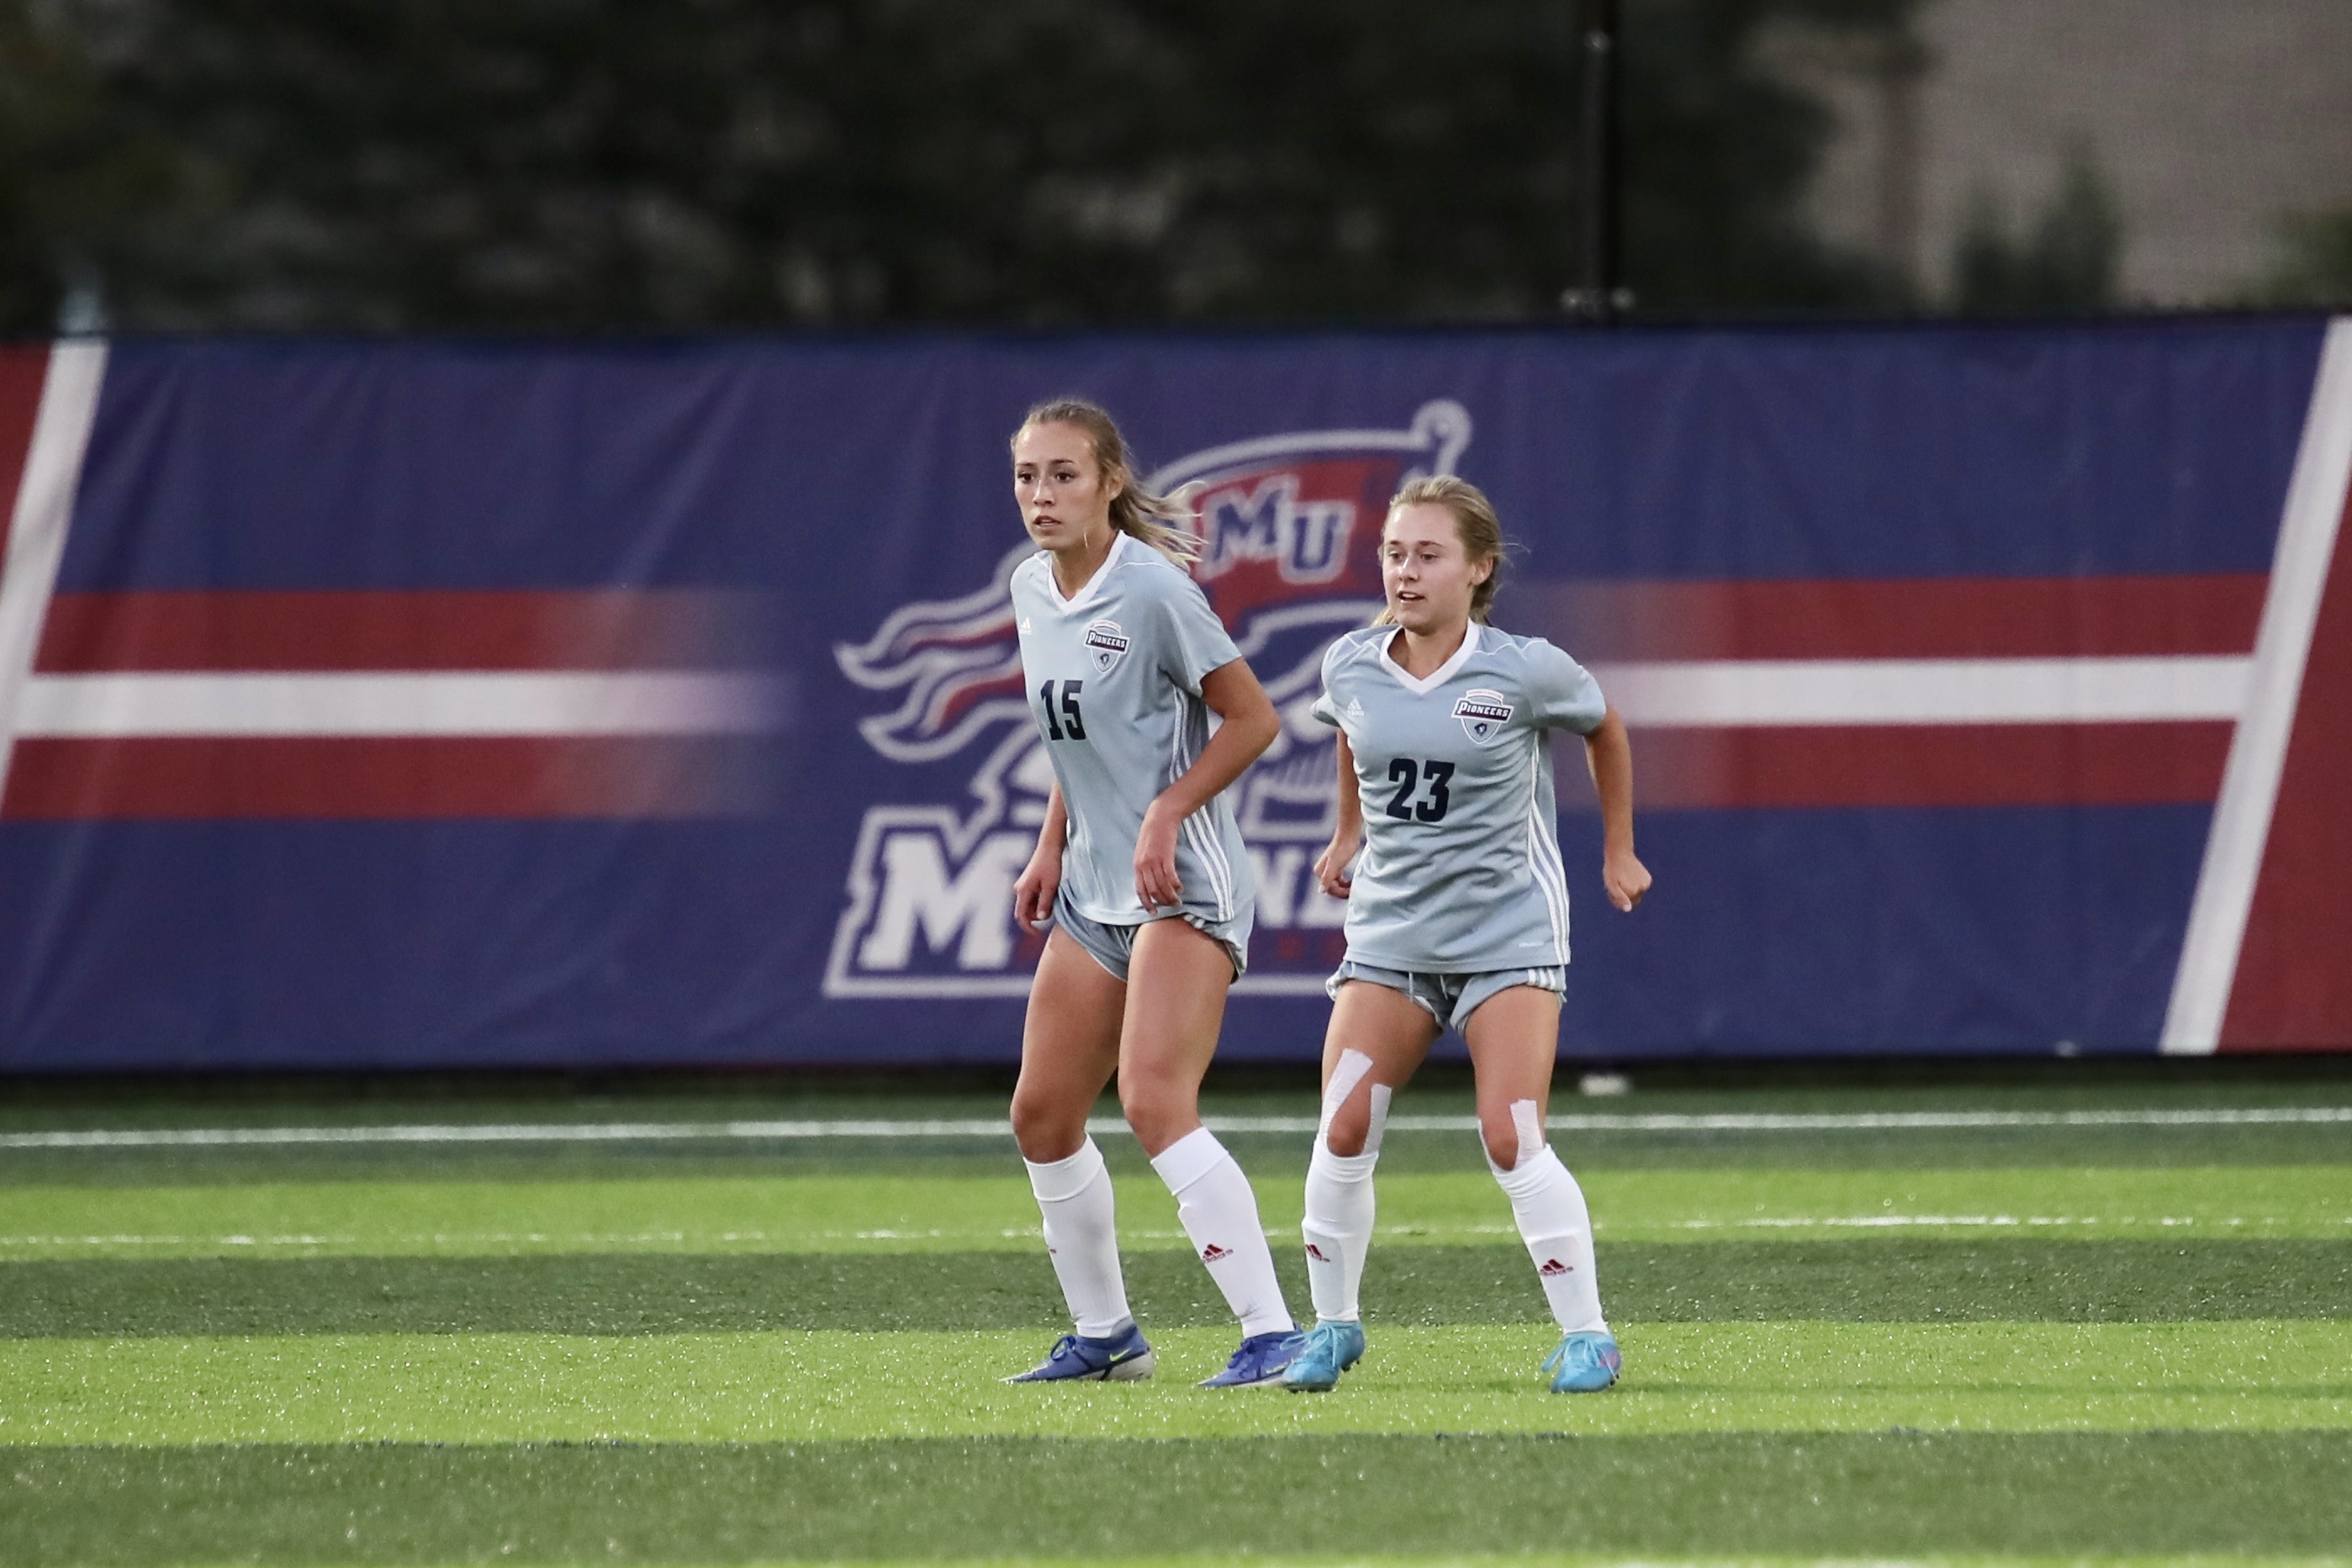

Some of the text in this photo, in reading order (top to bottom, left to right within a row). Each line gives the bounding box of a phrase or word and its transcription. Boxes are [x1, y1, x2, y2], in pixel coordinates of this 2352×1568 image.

[1202, 476, 1352, 581] MU
[1040, 680, 1086, 741] 15
[1386, 758, 1455, 822] 23
